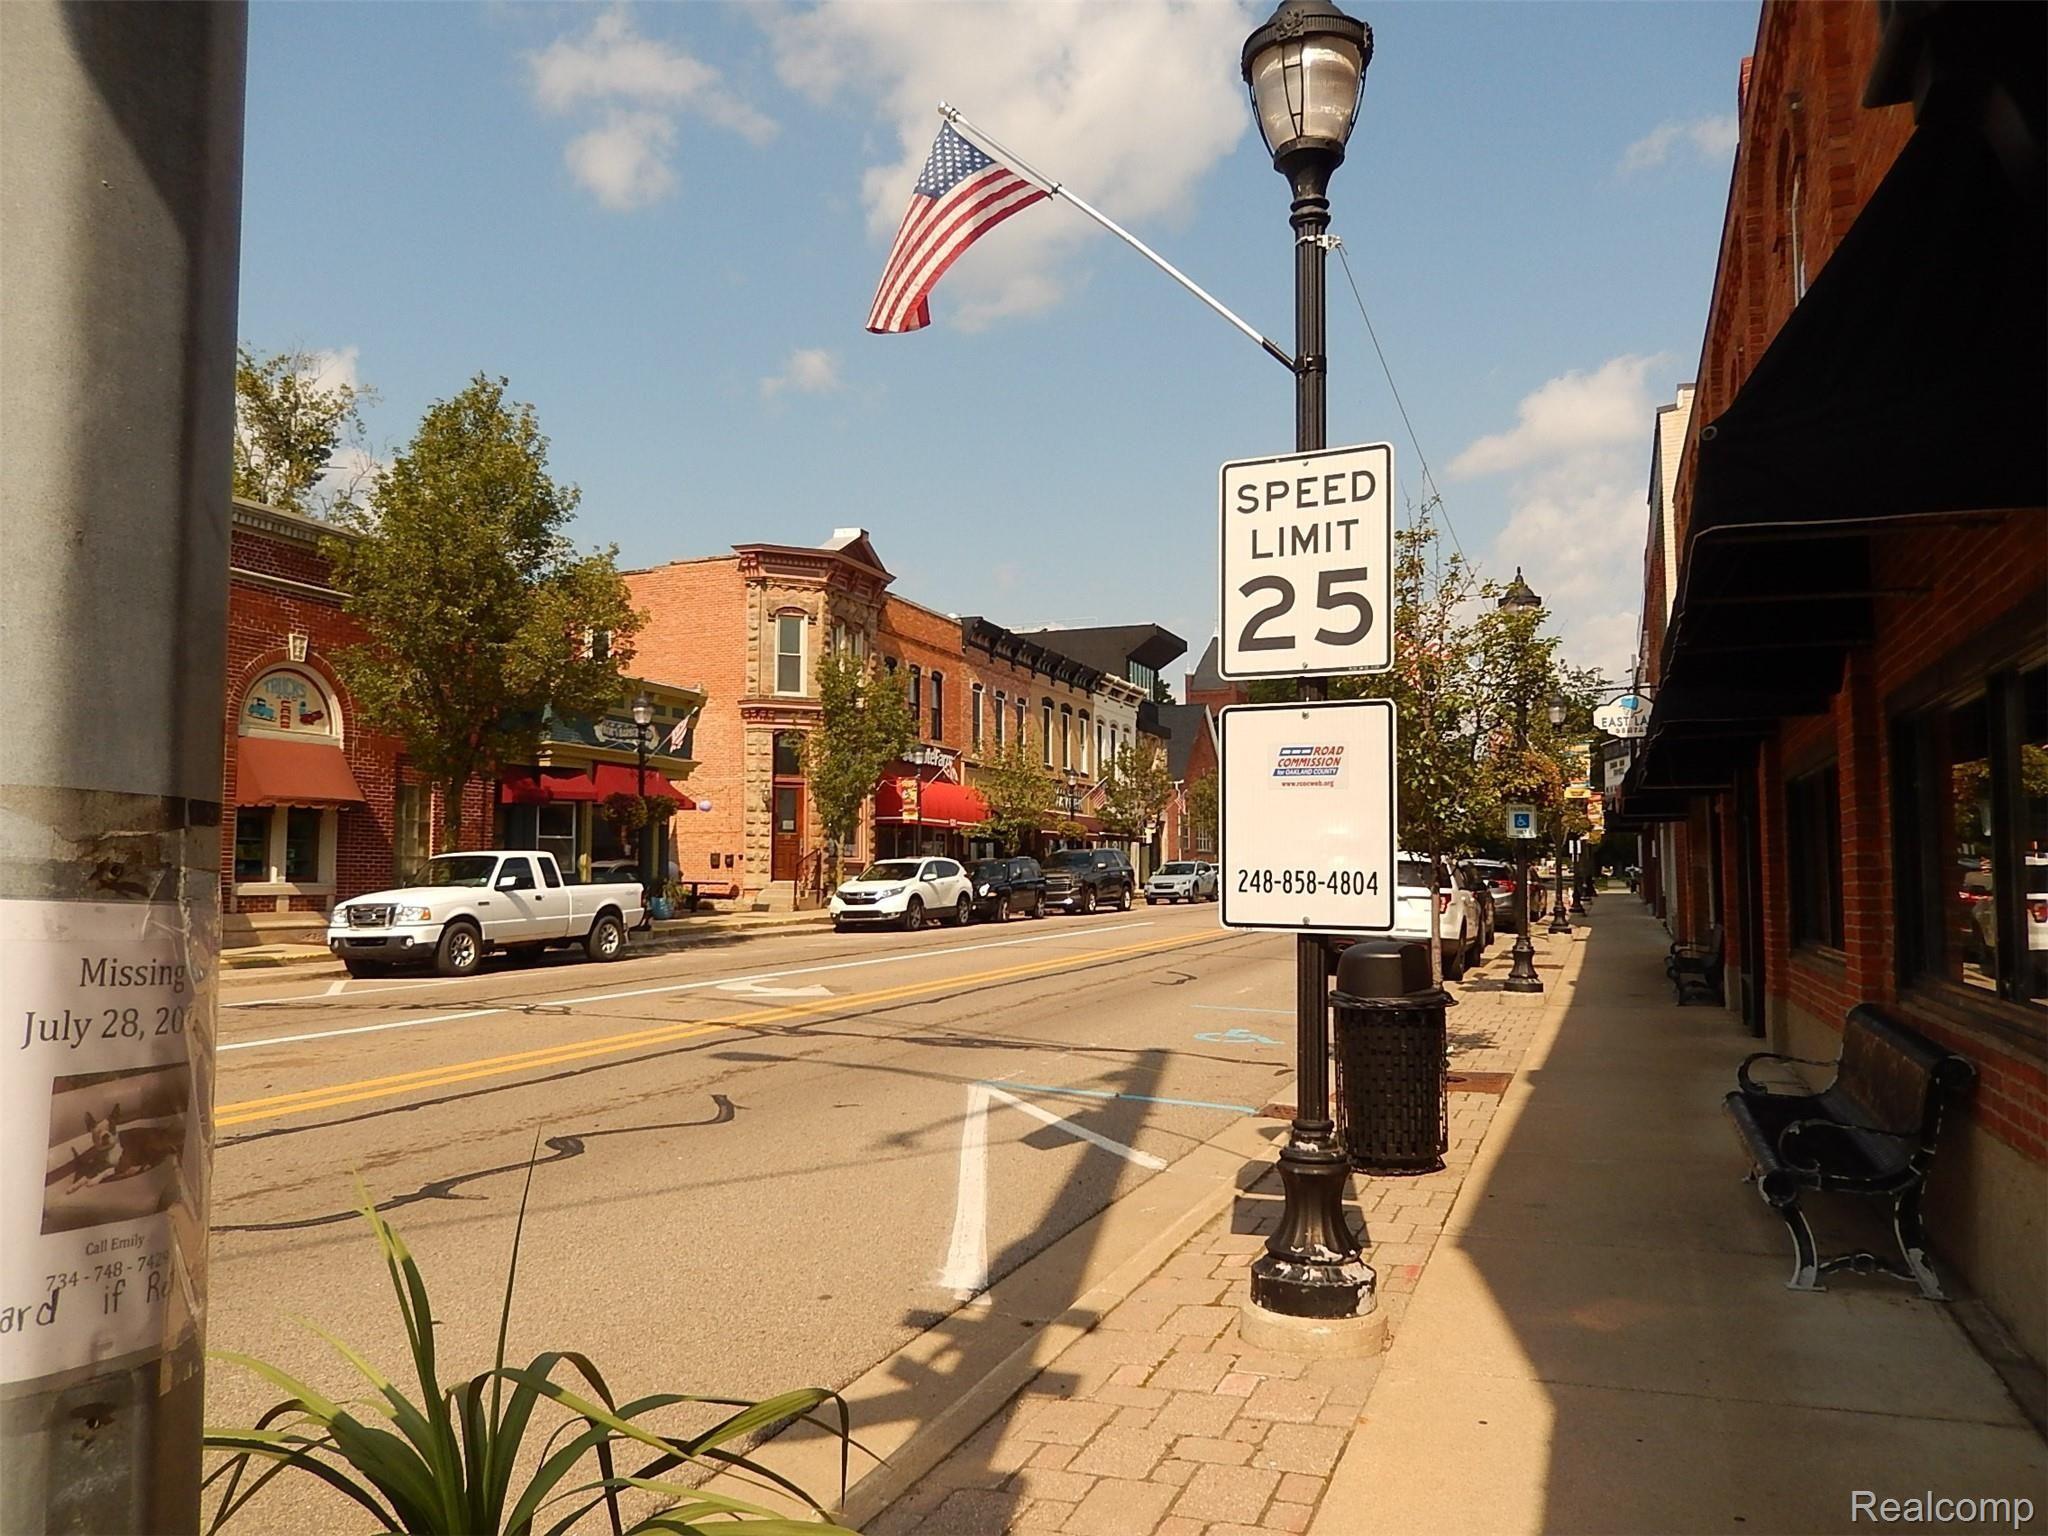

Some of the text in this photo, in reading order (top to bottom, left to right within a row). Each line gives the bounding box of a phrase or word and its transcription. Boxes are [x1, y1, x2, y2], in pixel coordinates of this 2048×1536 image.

[1237, 470, 1376, 514] SPEED
[1251, 518, 1360, 560] LIMIT
[1238, 567, 1374, 652] 25
[1601, 714, 1649, 728] EAST LA
[1615, 727, 1644, 735] DENTA
[1278, 756, 1342, 768] COMMISSION
[1313, 745, 1345, 756] ROAD
[1238, 869, 1379, 896] 248-858-4804
[79, 957, 186, 994] Missing
[20, 1006, 188, 1050] July 28, 20
[85, 1234, 146, 1256] Call Emily
[46, 1271, 80, 1292] 734
[94, 1261, 123, 1282] 748
[0, 1286, 60, 1334] ard
[104, 1279, 126, 1315] if
